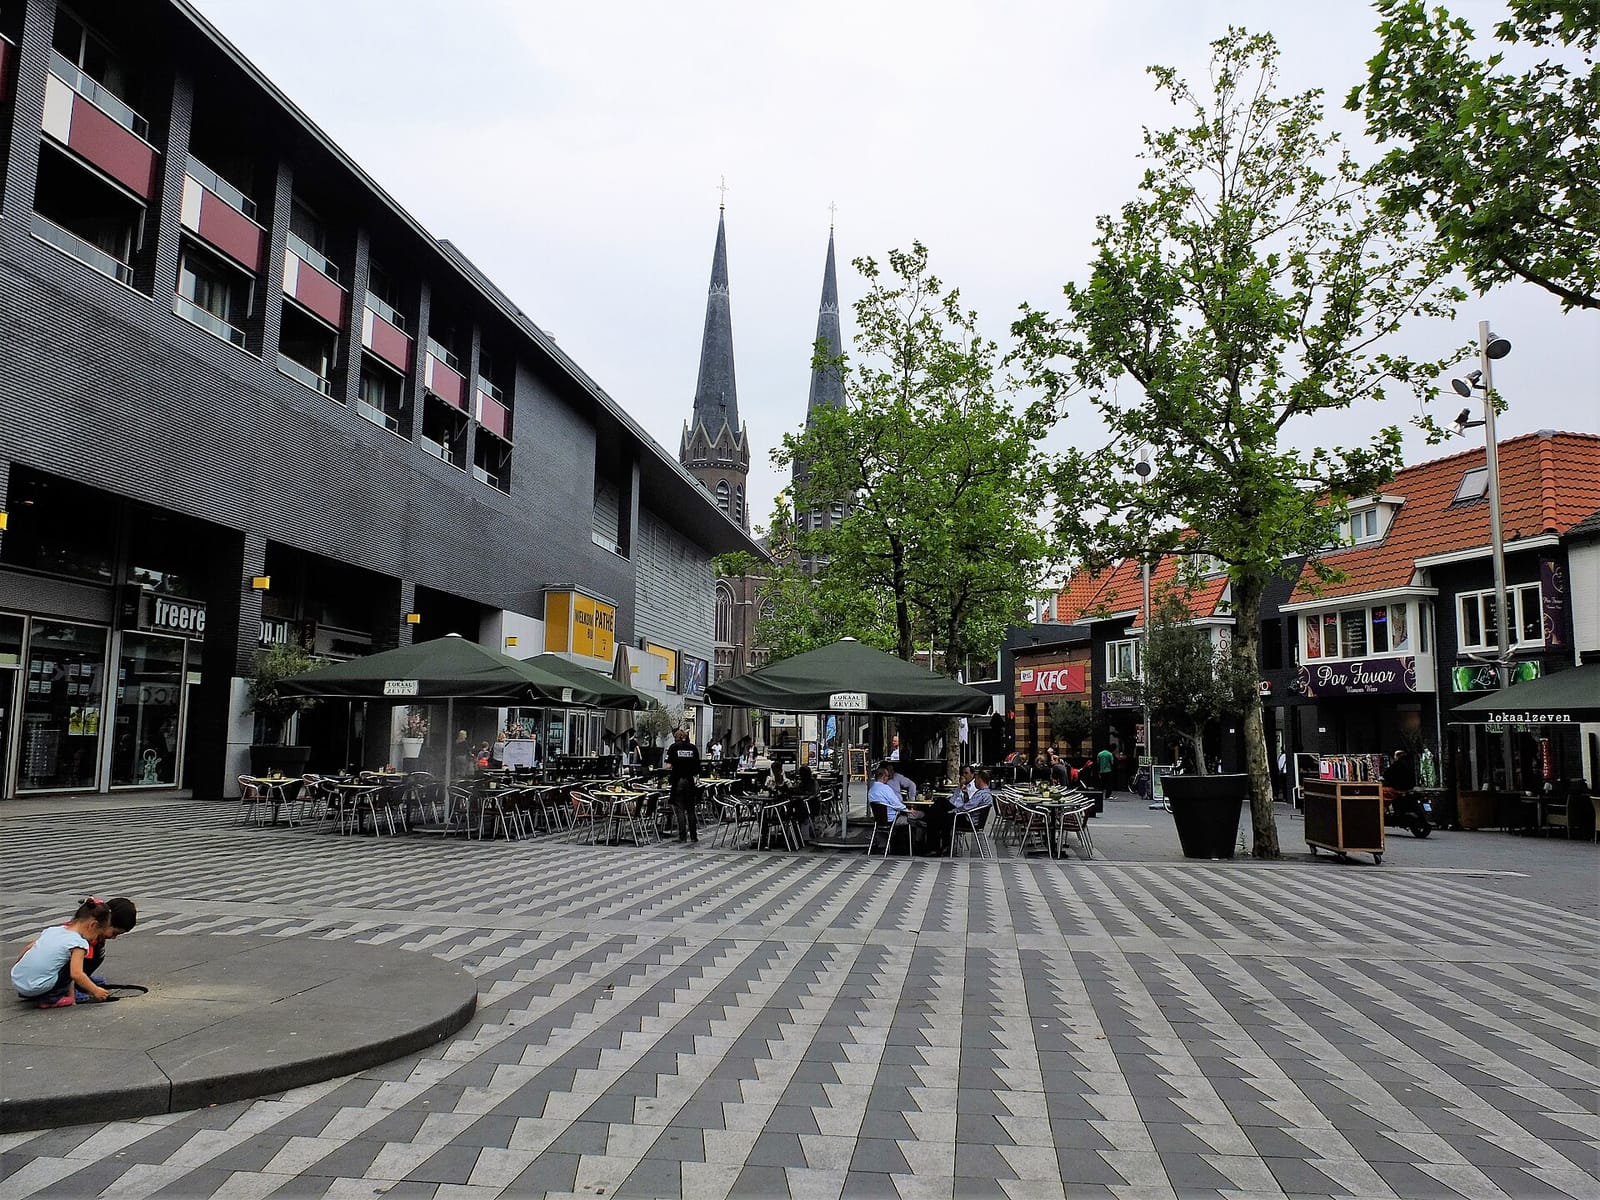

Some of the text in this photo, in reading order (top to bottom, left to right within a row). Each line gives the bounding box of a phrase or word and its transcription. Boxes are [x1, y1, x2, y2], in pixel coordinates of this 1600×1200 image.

[155, 598, 206, 632] freere
[595, 609, 613, 632] PATHÉ
[1035, 669, 1068, 692] KFC
[1317, 665, 1348, 687] Por
[1350, 662, 1396, 685] Favor
[1487, 711, 1572, 723] lokaalzeven
